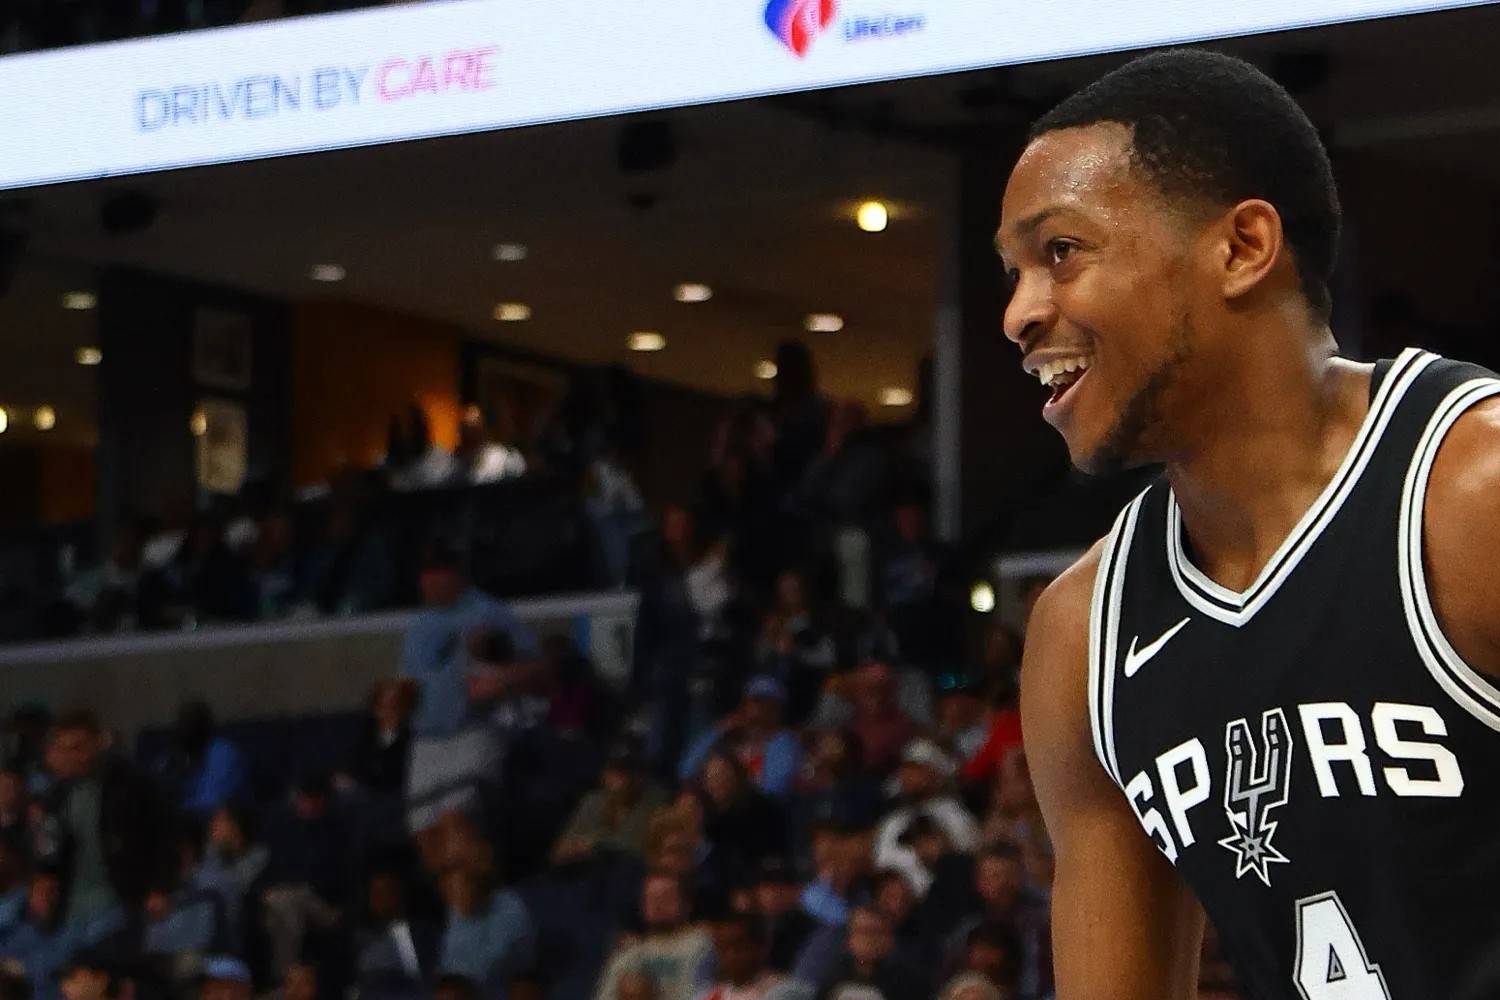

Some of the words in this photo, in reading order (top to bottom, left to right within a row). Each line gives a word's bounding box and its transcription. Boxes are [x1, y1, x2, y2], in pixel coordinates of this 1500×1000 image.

[136, 75, 301, 131] DRIVEN
[312, 66, 369, 109] BY
[375, 46, 498, 103] CARE
